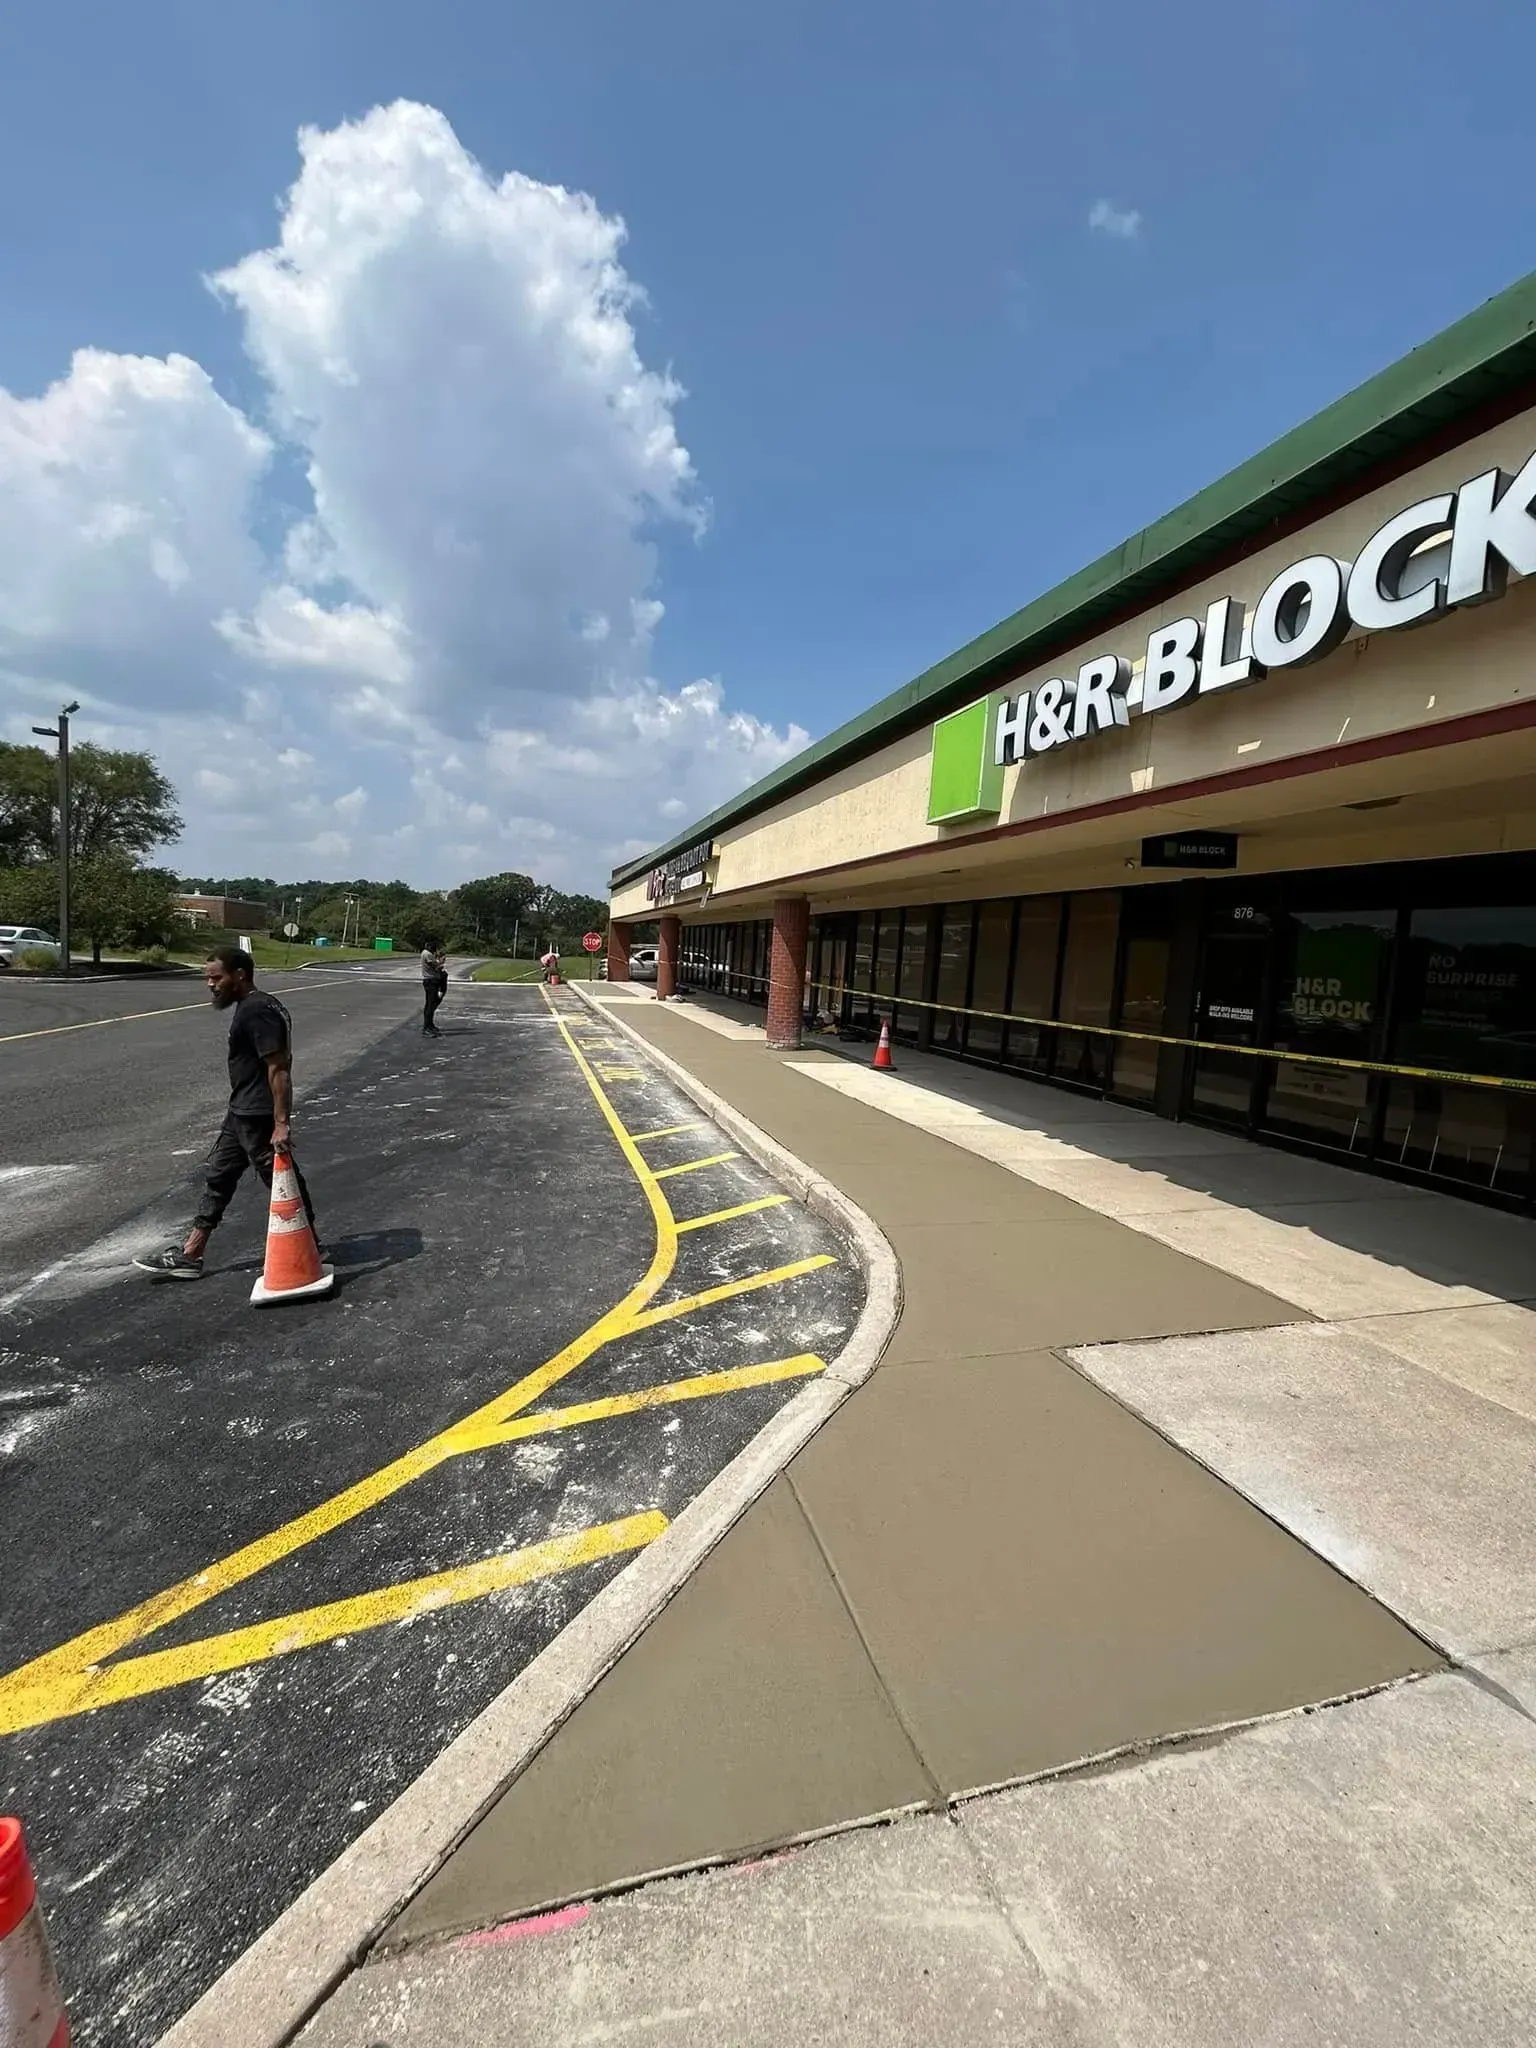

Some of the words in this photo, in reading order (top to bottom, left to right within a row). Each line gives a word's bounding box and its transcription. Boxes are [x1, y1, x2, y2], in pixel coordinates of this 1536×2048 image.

[994, 654, 1129, 767] H&R
[1142, 450, 1536, 715] BLOCK
[1179, 844, 1198, 854] H&R
[1199, 845, 1227, 855] BLOCK
[1234, 907, 1254, 919] 876
[584, 938, 601, 946] STOP
[1428, 953, 1456, 969] NO
[1296, 976, 1342, 997] H&R
[1426, 971, 1520, 987] SURPRISE
[1293, 997, 1372, 1021] BLOCK
